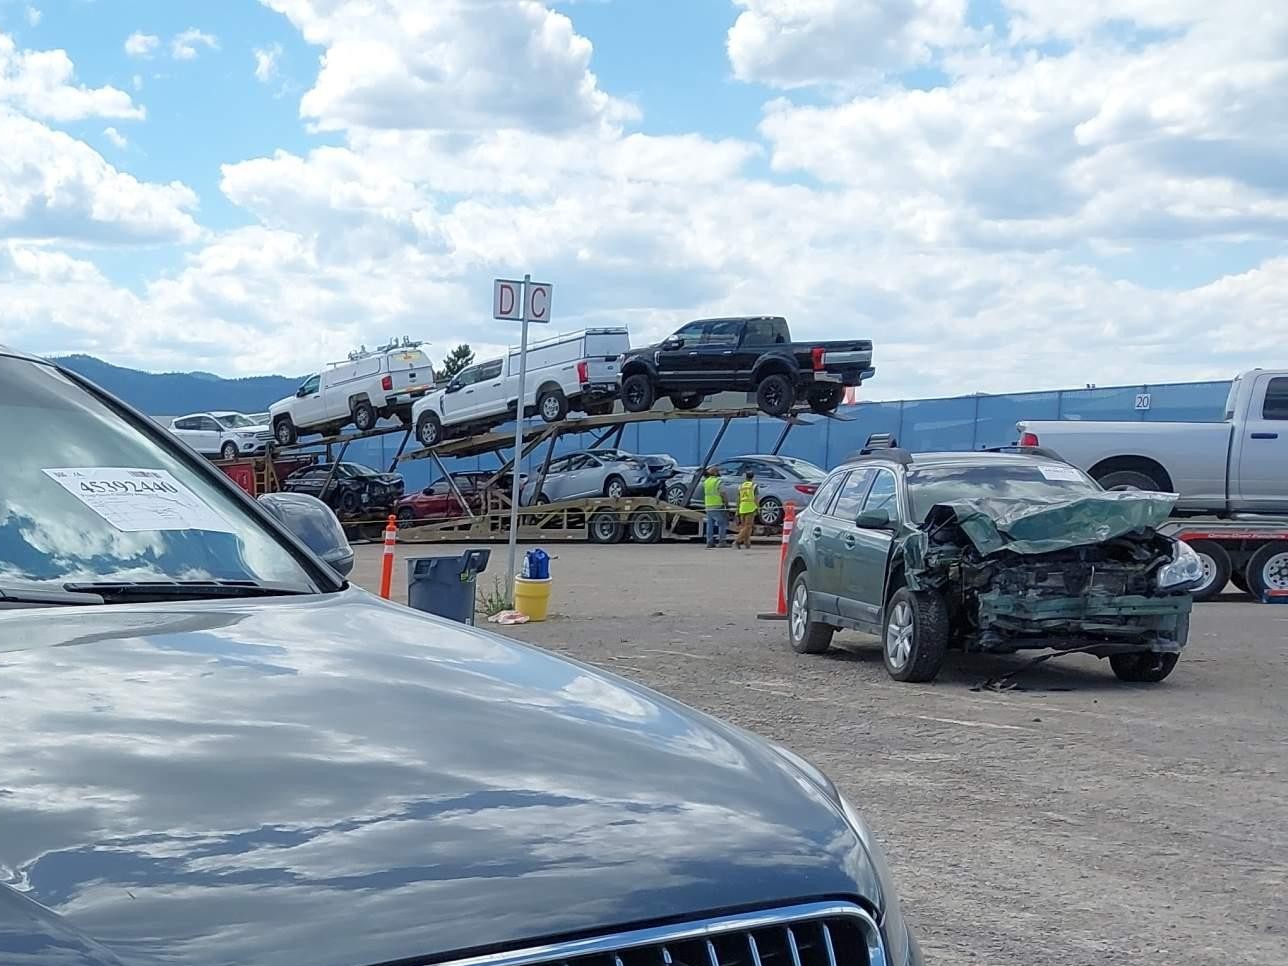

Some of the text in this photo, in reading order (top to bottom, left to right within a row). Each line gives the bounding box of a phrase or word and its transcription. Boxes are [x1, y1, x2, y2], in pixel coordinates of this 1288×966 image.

[499, 284, 514, 315] D
[531, 287, 546, 318] C
[1135, 395, 1150, 408] 20
[80, 481, 178, 493] 45392440
